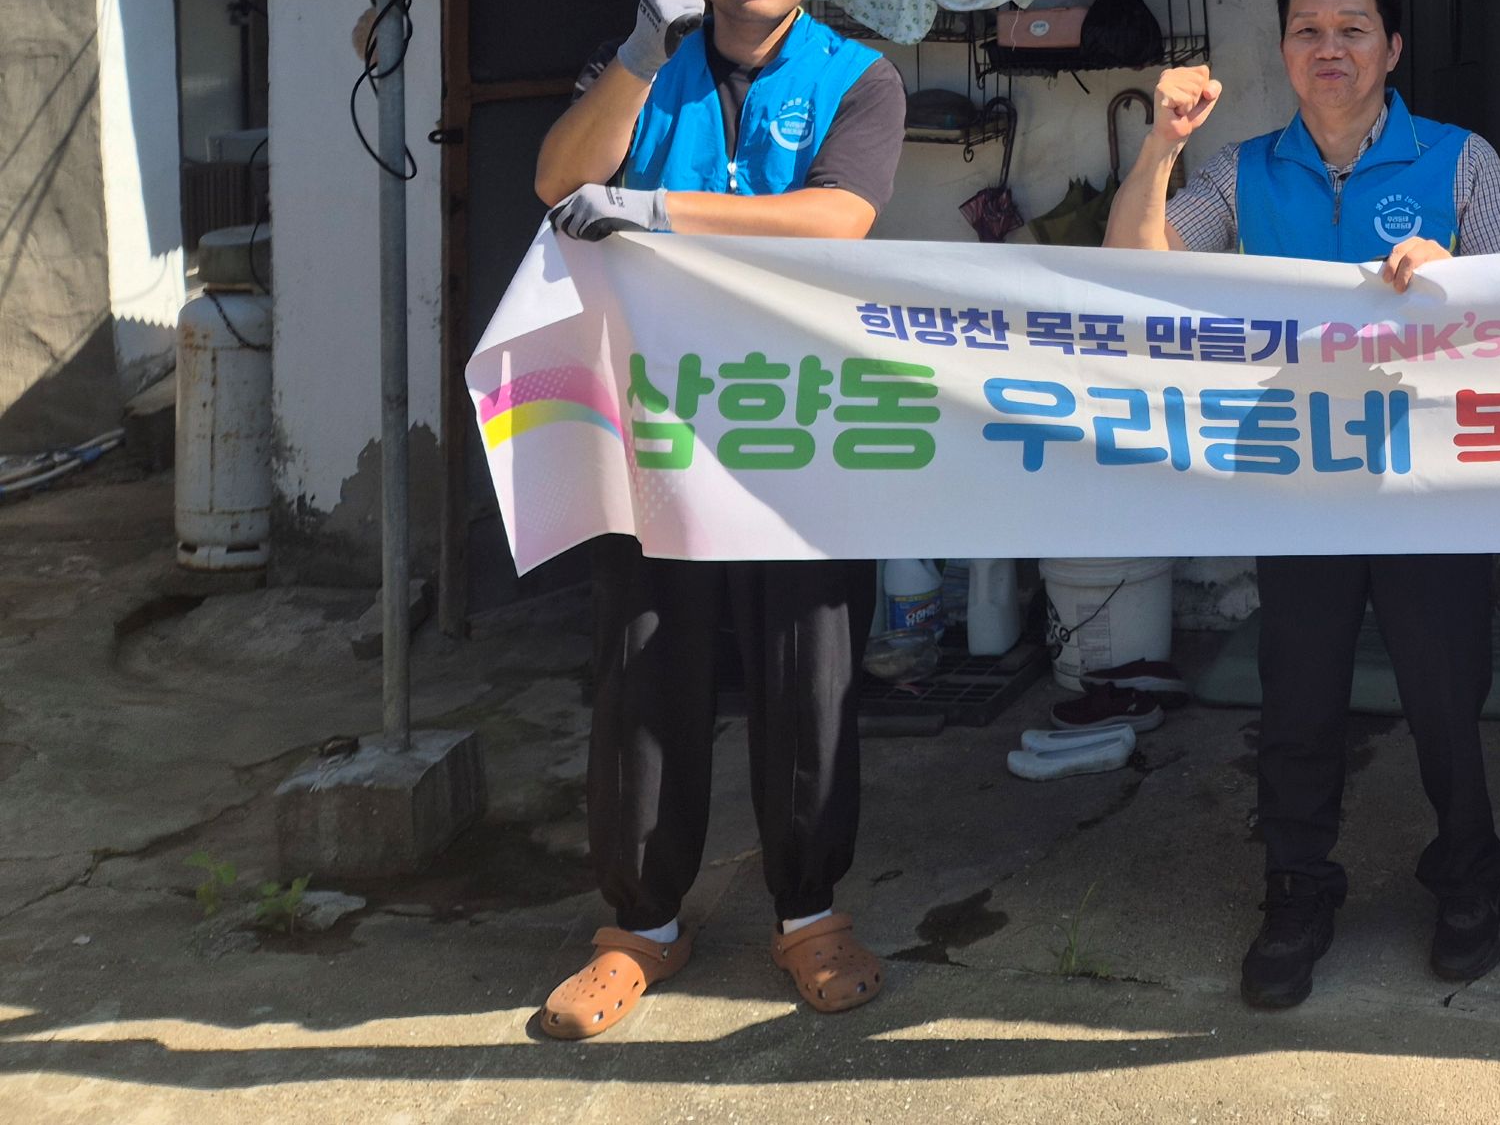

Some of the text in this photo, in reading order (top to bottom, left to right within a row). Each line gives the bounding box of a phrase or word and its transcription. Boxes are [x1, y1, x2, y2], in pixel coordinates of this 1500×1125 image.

[856, 302, 1010, 351] 희망찬
[1026, 311, 1128, 356] 목포
[1145, 315, 1300, 364] 만들기
[627, 351, 941, 471] 삼향동
[982, 377, 1412, 476] 우리동네
